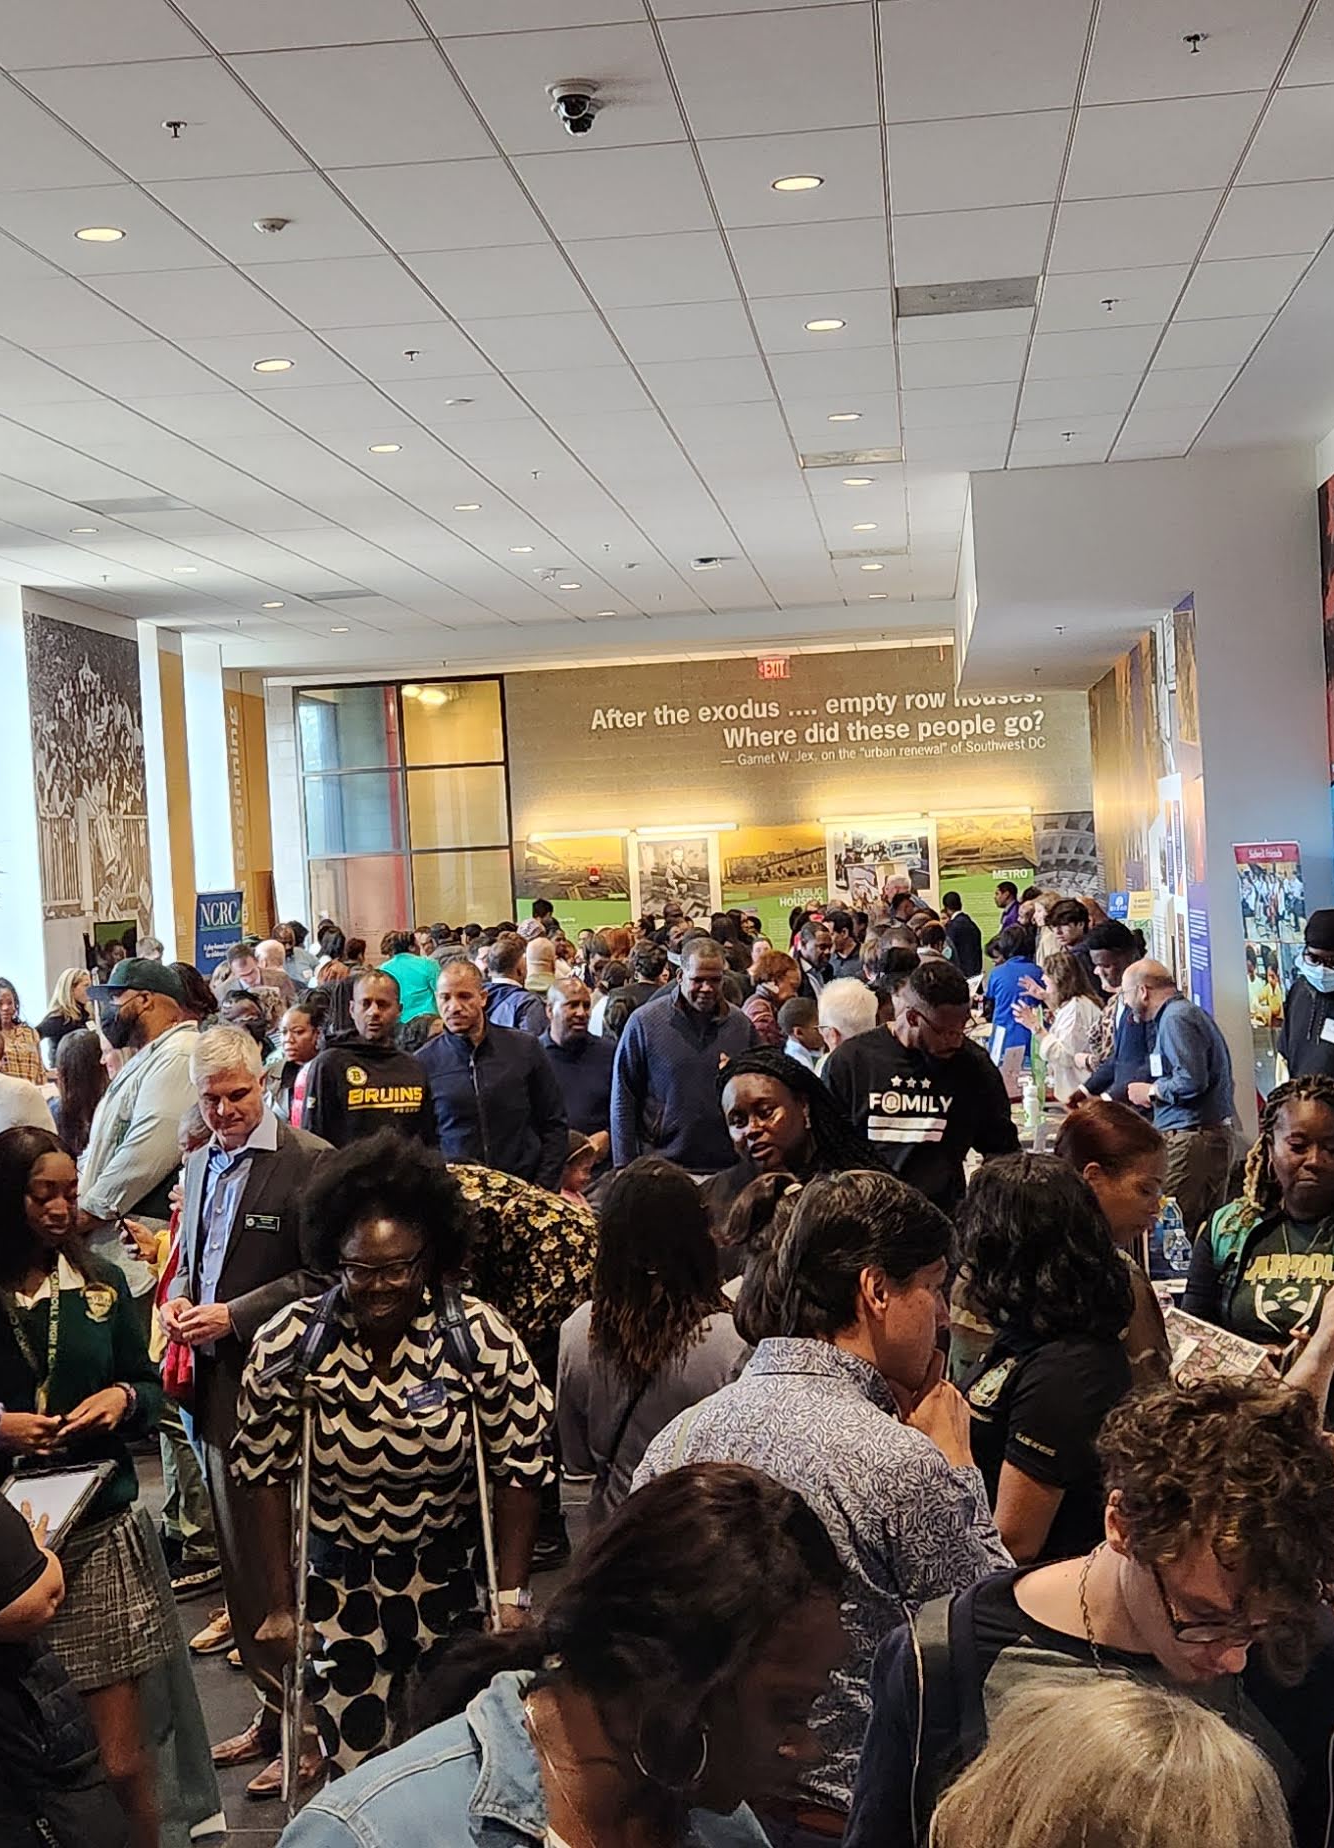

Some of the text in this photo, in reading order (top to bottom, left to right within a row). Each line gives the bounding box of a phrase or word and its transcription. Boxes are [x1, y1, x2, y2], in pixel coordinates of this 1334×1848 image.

[763, 659, 786, 679] EXIT
[591, 707, 647, 730] After
[654, 704, 691, 726] the
[698, 698, 780, 722] exodus
[826, 692, 898, 717] empty
[905, 692, 947, 710] row
[723, 710, 1045, 749] Where did these people go?
[737, 751, 776, 766] Garnet
[778, 751, 792, 764] W.
[795, 750, 817, 764] Jex,
[821, 750, 836, 761] on
[838, 748, 857, 760] the
[951, 742, 964, 754] of
[965, 738, 1026, 753] Southwest
[1028, 736, 1046, 750] DC
[992, 868, 1028, 880] METRO
[200, 900, 238, 928] NCRC
[348, 1086, 423, 1105] BRUINS
